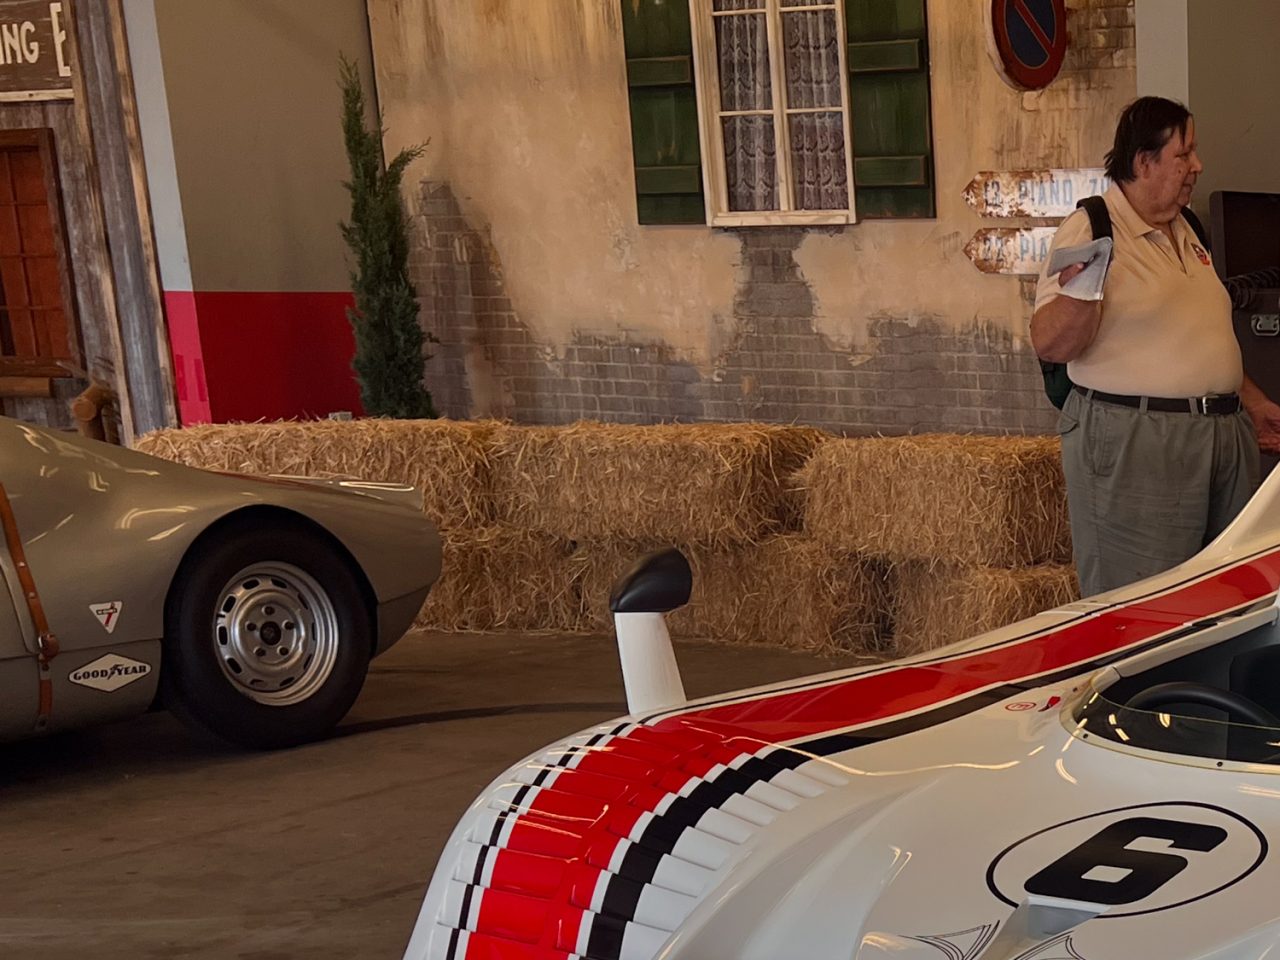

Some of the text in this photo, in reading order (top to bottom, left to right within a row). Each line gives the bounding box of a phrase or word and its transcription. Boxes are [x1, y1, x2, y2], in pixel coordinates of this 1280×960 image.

[1018, 178, 1073, 206] PIANO
[73, 665, 147, 681] GOOD YEAR
[1024, 817, 1229, 905] 6
